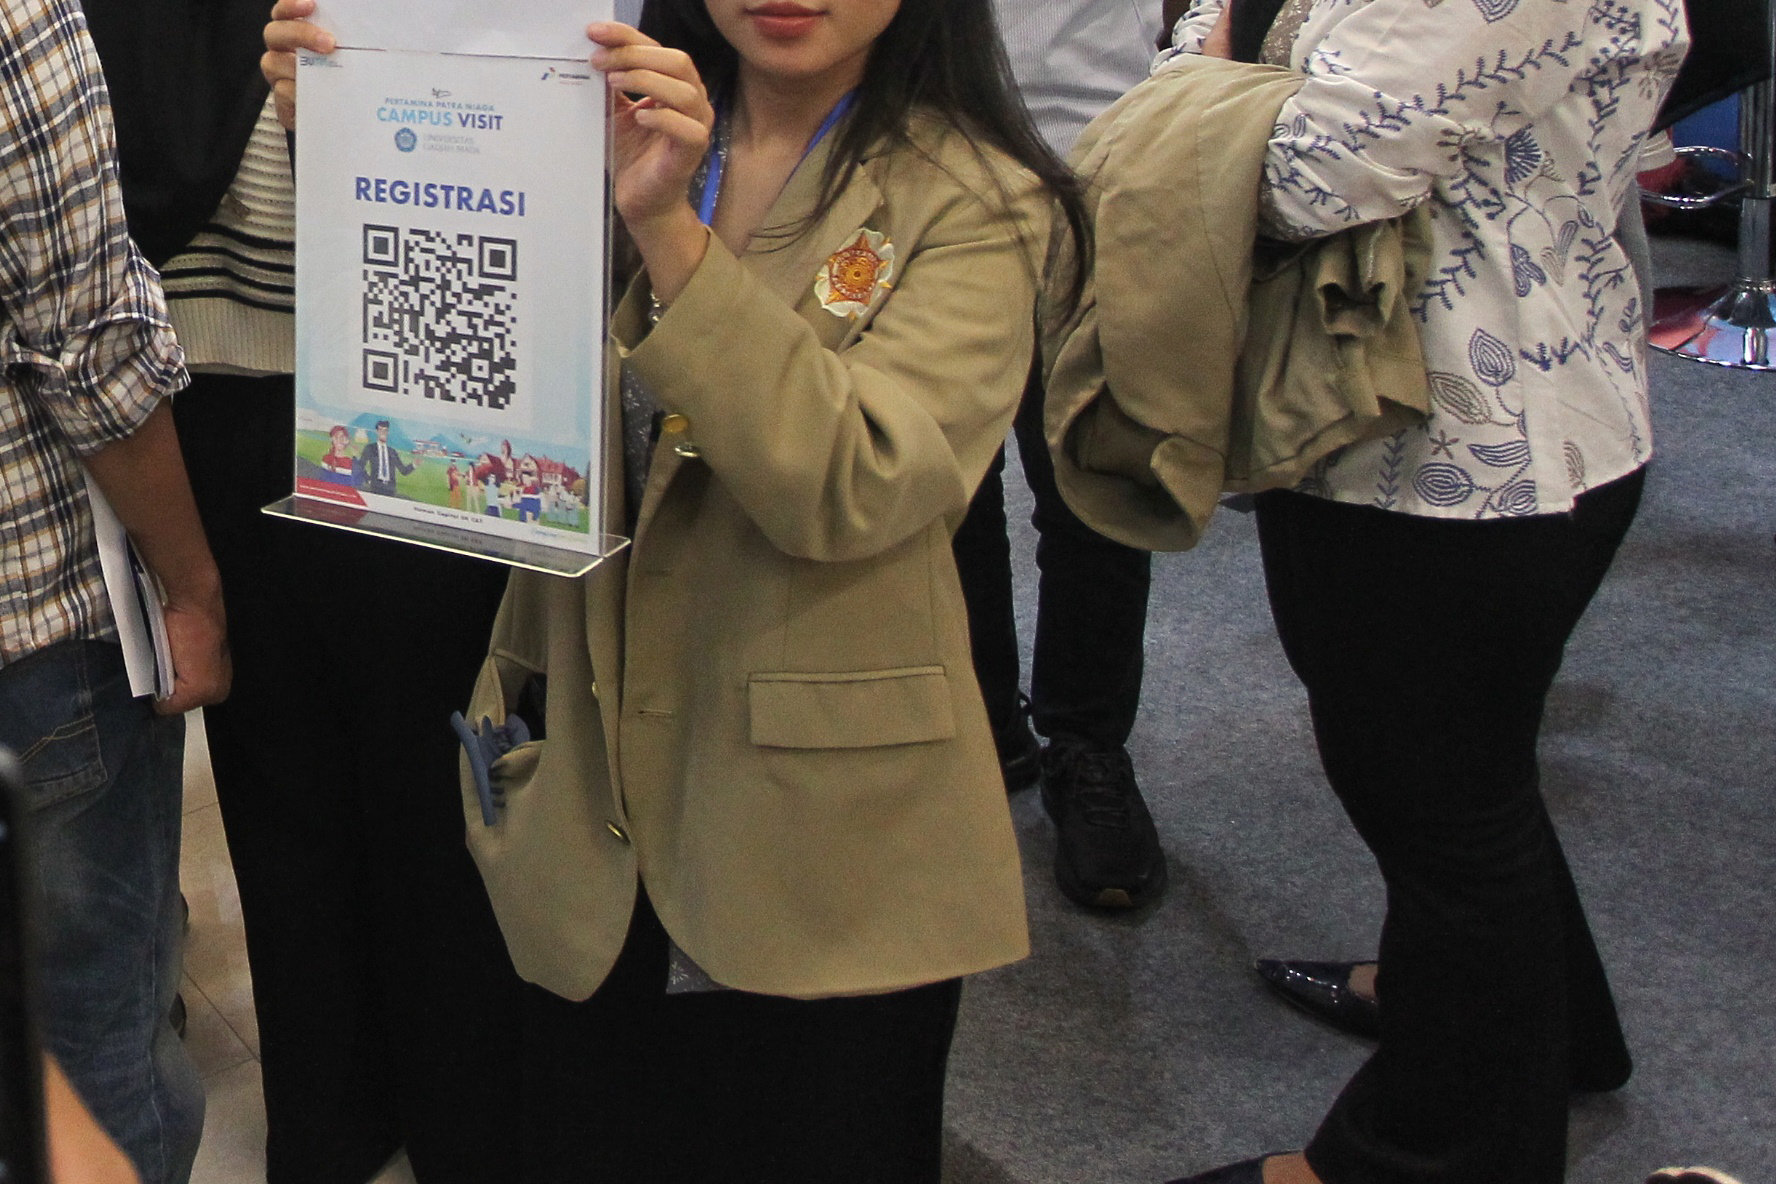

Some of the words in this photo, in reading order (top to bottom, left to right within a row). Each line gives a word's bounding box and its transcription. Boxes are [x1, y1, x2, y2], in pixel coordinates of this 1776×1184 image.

[385, 97, 434, 107] PERTAMINA
[436, 101, 464, 109] PATRA
[377, 106, 453, 126] CAMPUS
[457, 112, 504, 130] VISIT
[355, 176, 526, 217] REGISTRASI
